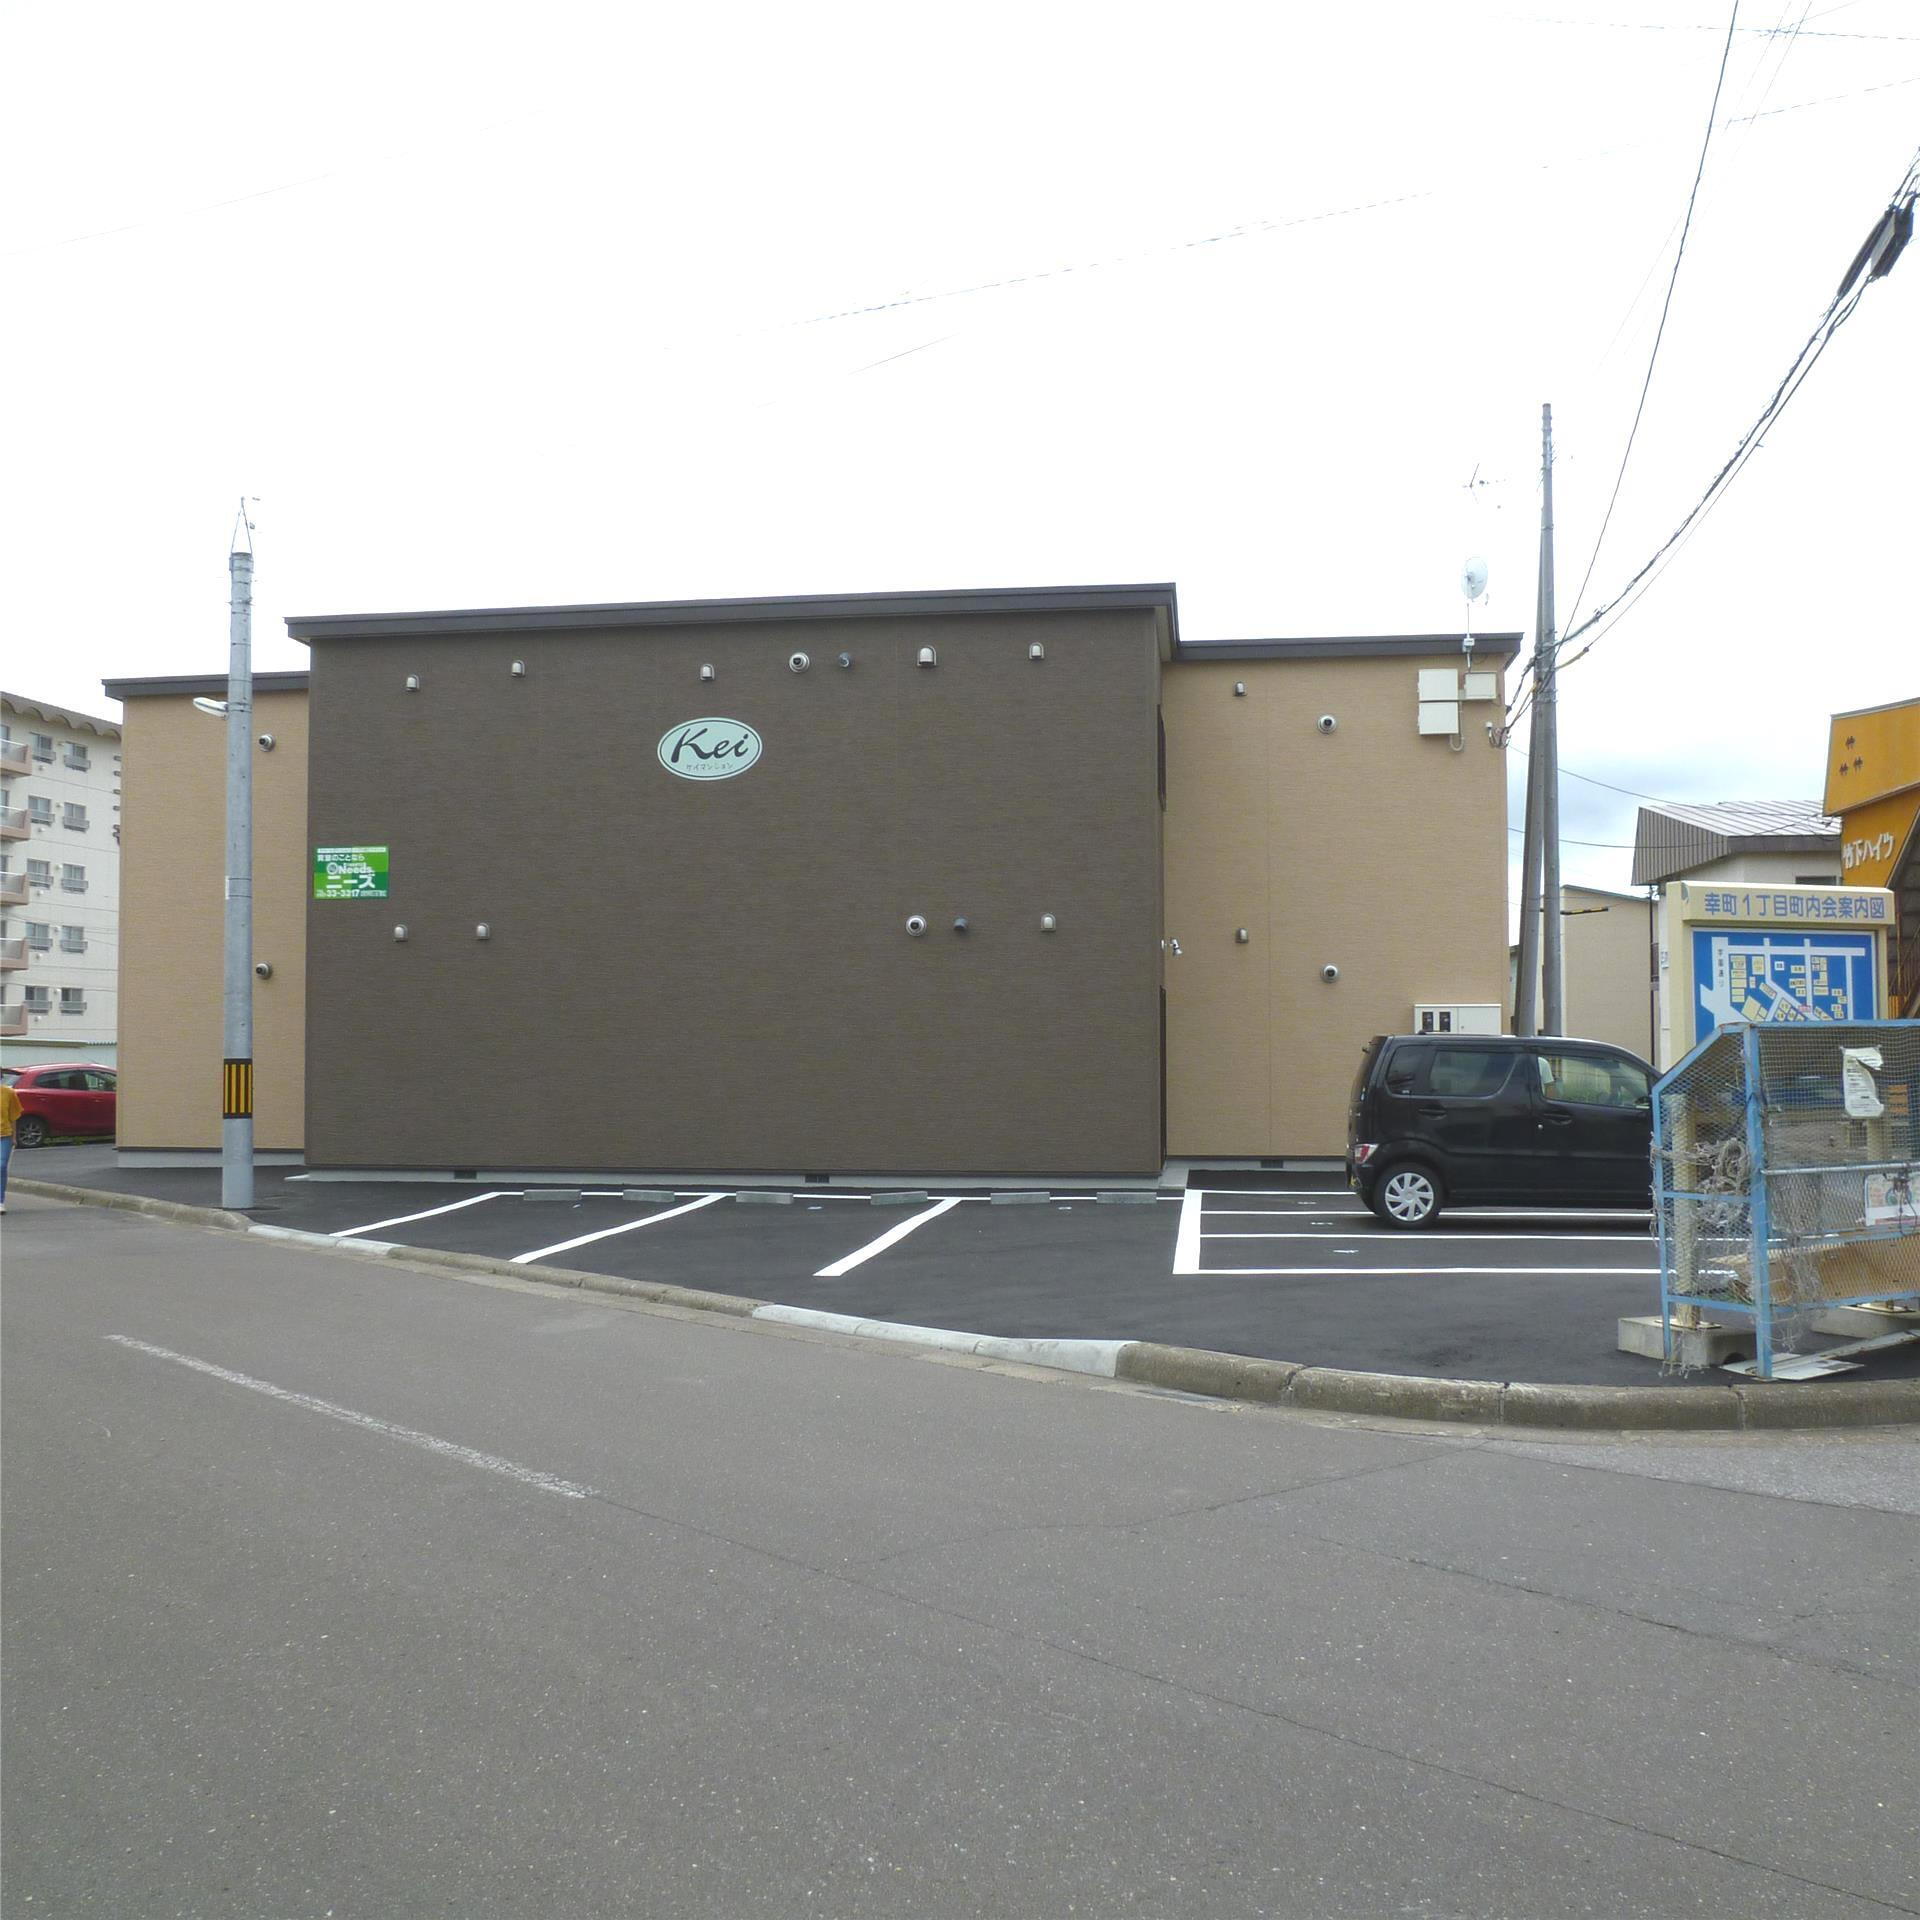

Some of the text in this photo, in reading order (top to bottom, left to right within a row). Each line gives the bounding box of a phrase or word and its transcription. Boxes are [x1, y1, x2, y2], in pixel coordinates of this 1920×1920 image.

[670, 727, 749, 764] Kei
[326, 873, 376, 889] ニーズ
